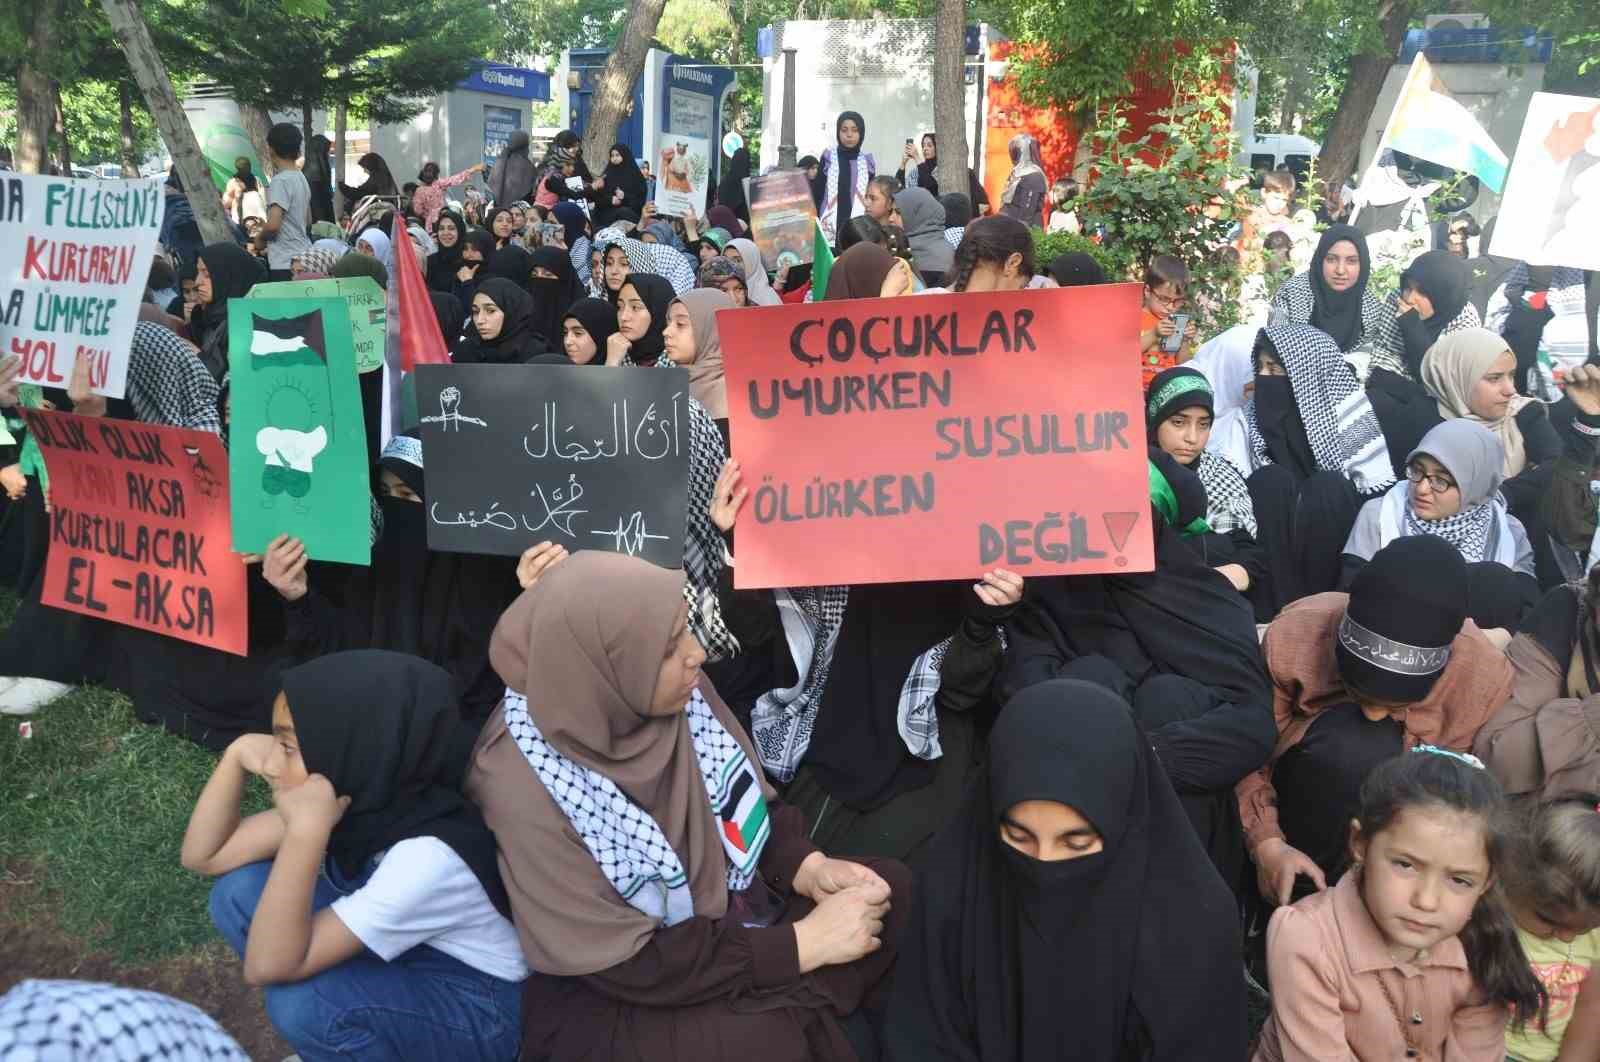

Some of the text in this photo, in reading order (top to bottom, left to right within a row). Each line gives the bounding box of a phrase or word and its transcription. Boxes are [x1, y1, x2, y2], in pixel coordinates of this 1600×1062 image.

[23, 236, 136, 284] KURTARIN
[34, 287, 117, 336] ÜMMETE
[11, 337, 64, 383] YOL
[789, 308, 1036, 368] ÇOÇUKLAR
[748, 369, 952, 420] UYURKEN
[100, 423, 175, 468] OLUK
[935, 411, 1129, 462] SUSULUR
[126, 470, 185, 519] AKSA
[753, 471, 935, 525] ÖLÜRKEN
[52, 505, 207, 577] KURTULACAK
